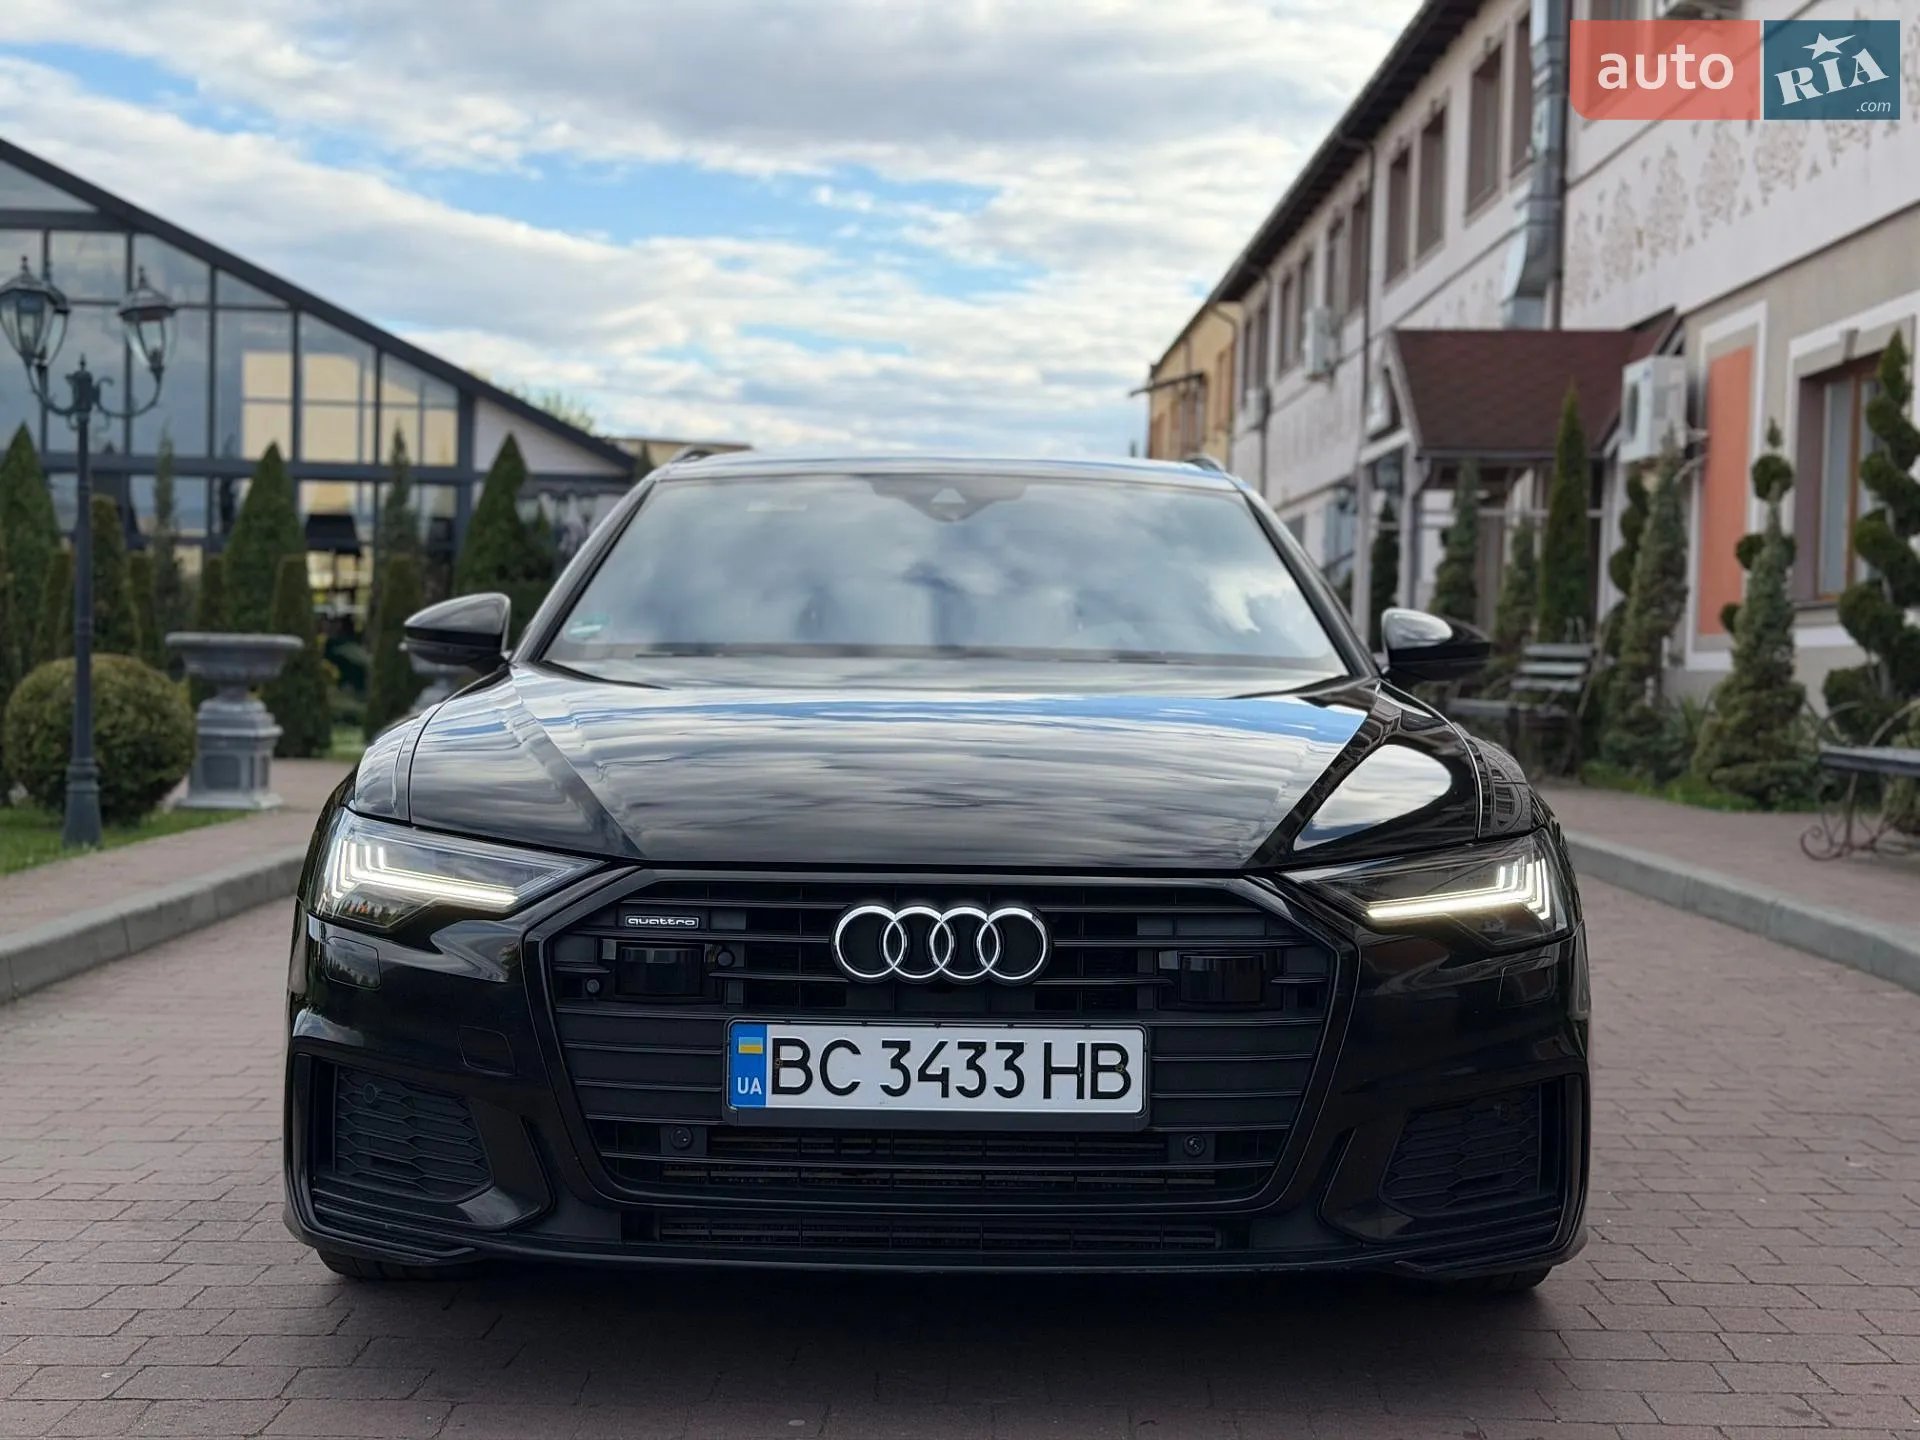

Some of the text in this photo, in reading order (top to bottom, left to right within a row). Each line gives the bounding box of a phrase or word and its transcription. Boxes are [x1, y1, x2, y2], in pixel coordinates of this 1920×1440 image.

[628, 918, 696, 926] quattro
[771, 1037, 1131, 1100] BC 3433 HB
[737, 1077, 762, 1095] UA
